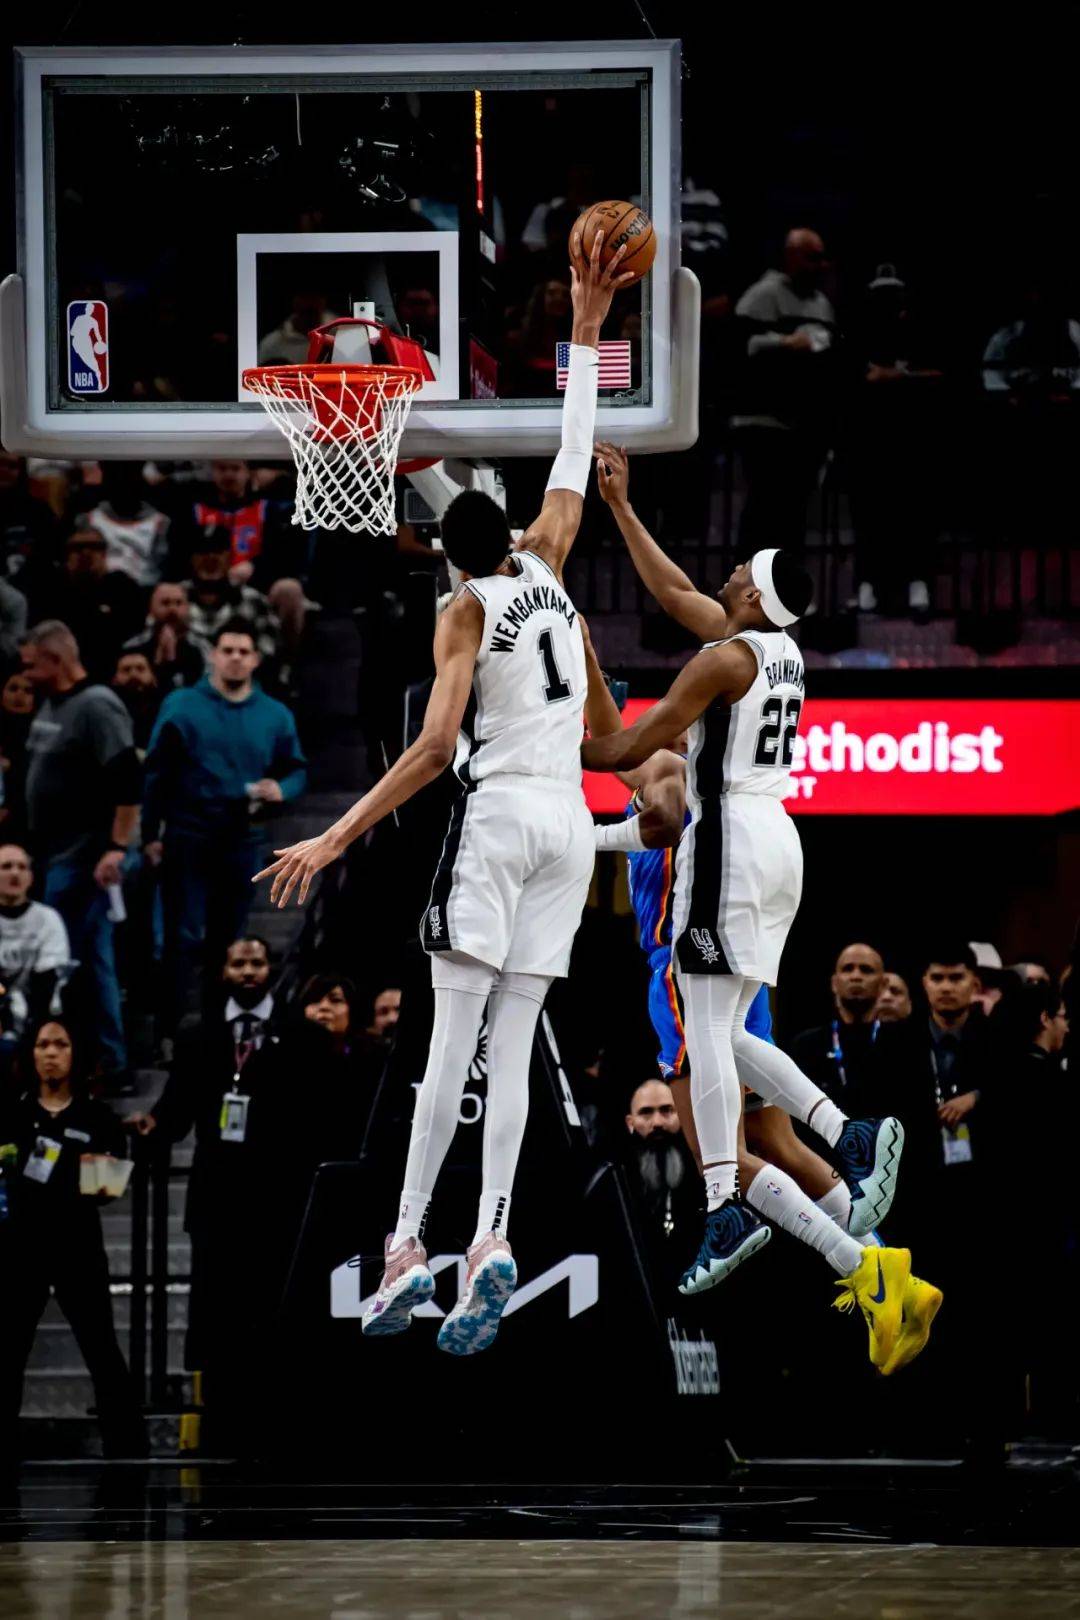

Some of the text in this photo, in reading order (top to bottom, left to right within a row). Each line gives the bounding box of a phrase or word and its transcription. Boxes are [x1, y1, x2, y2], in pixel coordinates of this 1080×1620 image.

[74, 372, 94, 387] NBA
[489, 586, 576, 653] WEMBANYAMA
[537, 627, 574, 705] 1
[752, 695, 802, 769] 22
